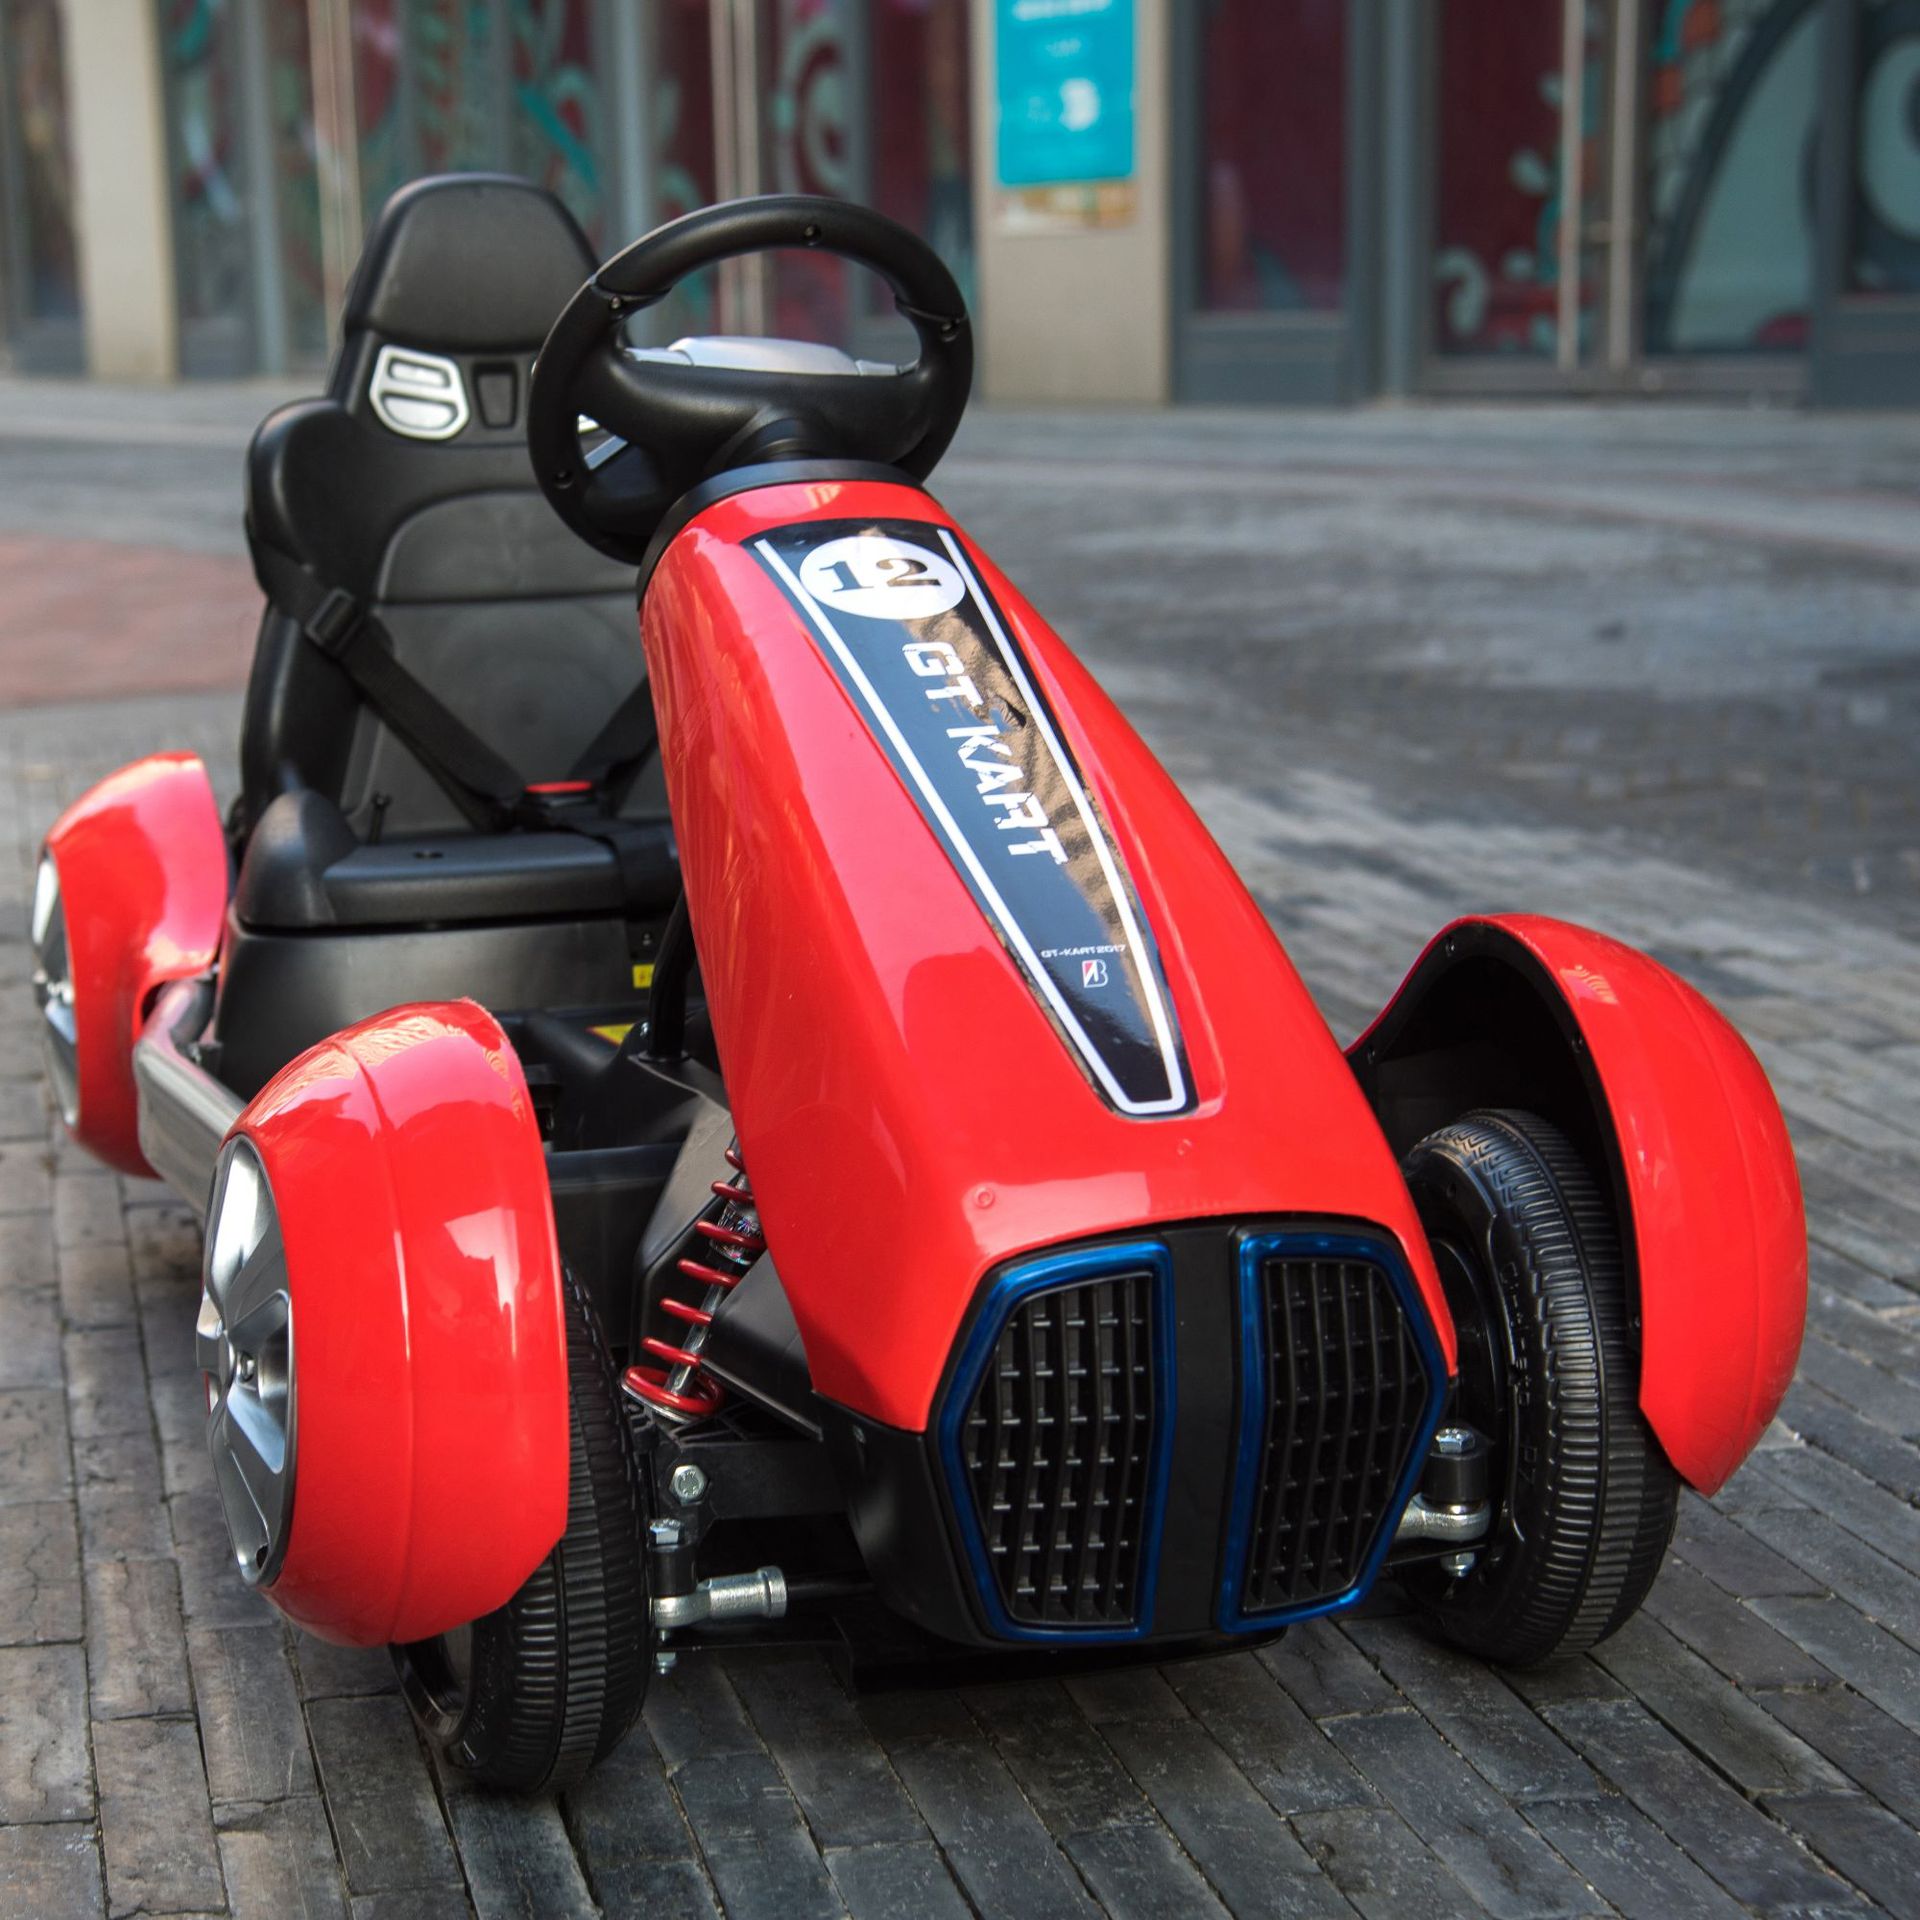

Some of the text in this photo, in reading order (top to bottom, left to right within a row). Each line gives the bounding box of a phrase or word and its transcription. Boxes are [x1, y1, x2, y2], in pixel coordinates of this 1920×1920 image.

[818, 558, 942, 593] 12
[902, 641, 1069, 865] GT KART
